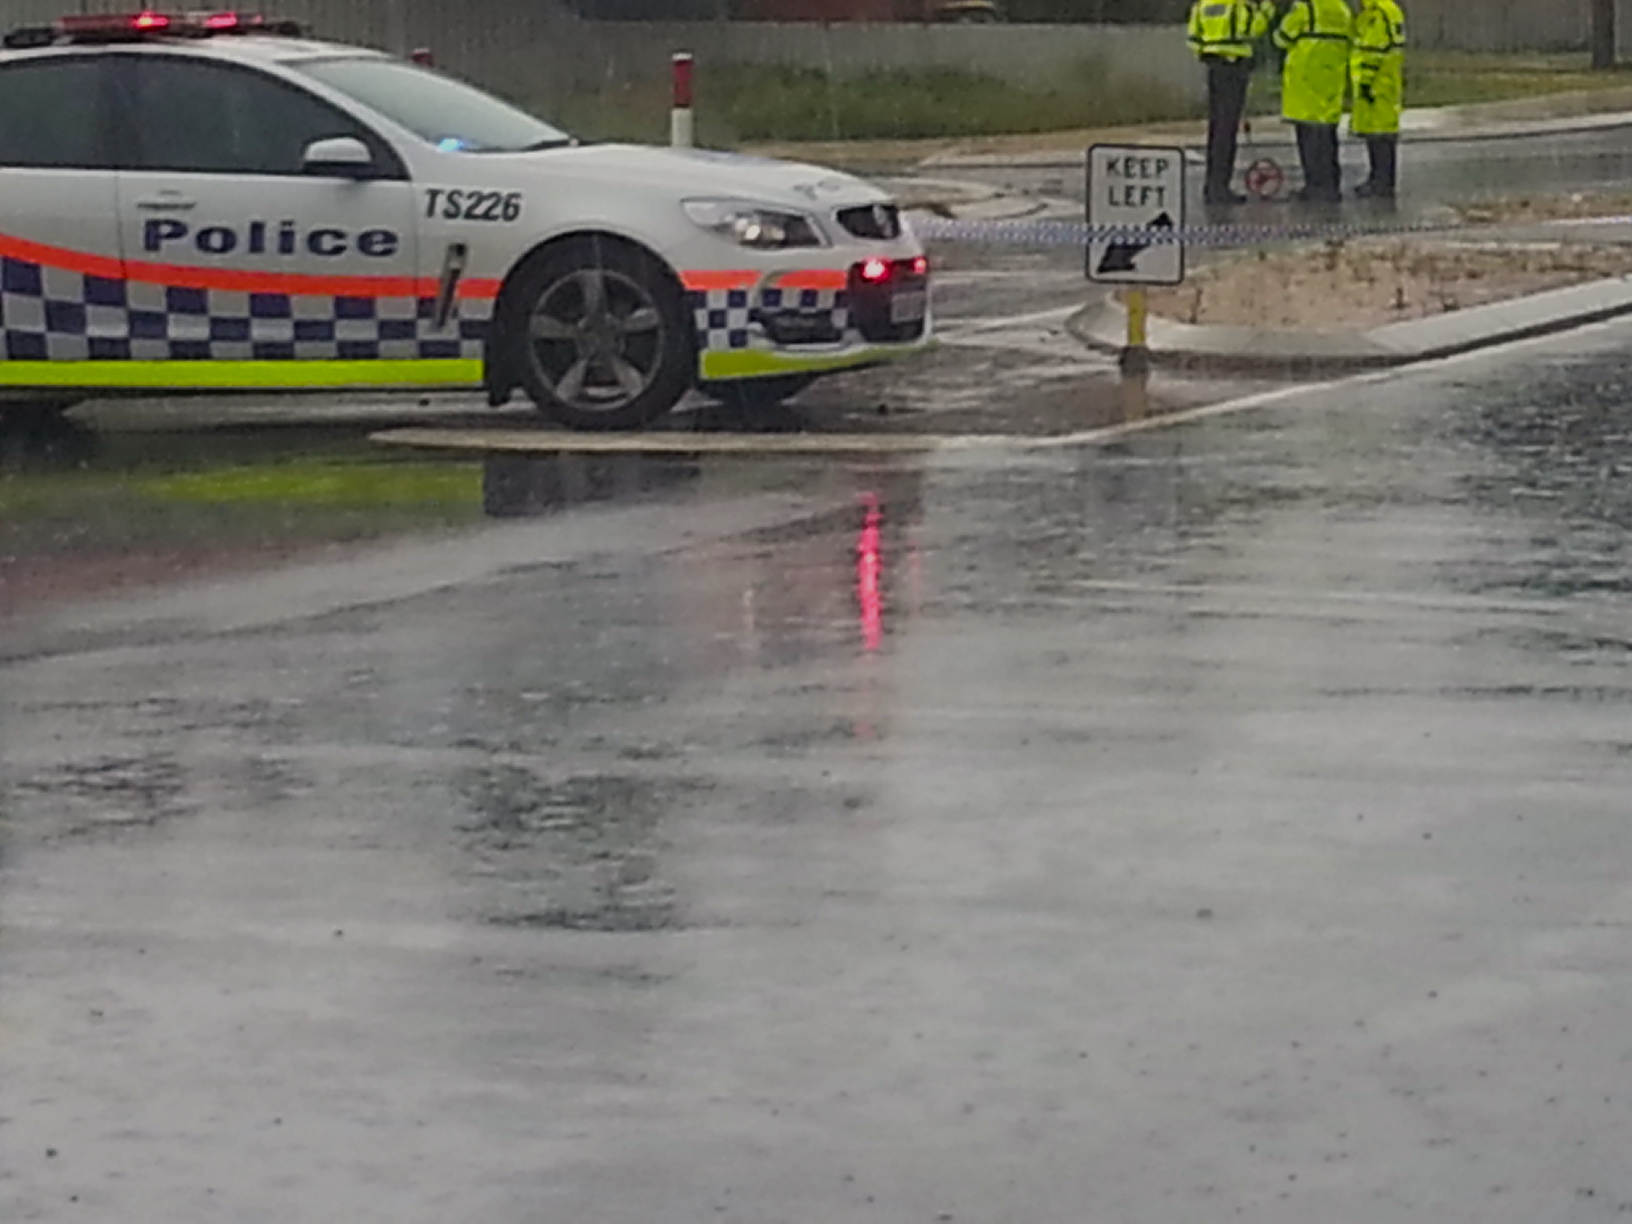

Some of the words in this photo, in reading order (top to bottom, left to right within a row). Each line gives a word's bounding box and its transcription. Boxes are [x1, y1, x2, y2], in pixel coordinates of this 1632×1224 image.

[1106, 157, 1169, 179] KEEP
[424, 188, 522, 222] TS226
[1109, 185, 1165, 207] LEFT
[143, 218, 399, 257] Police
